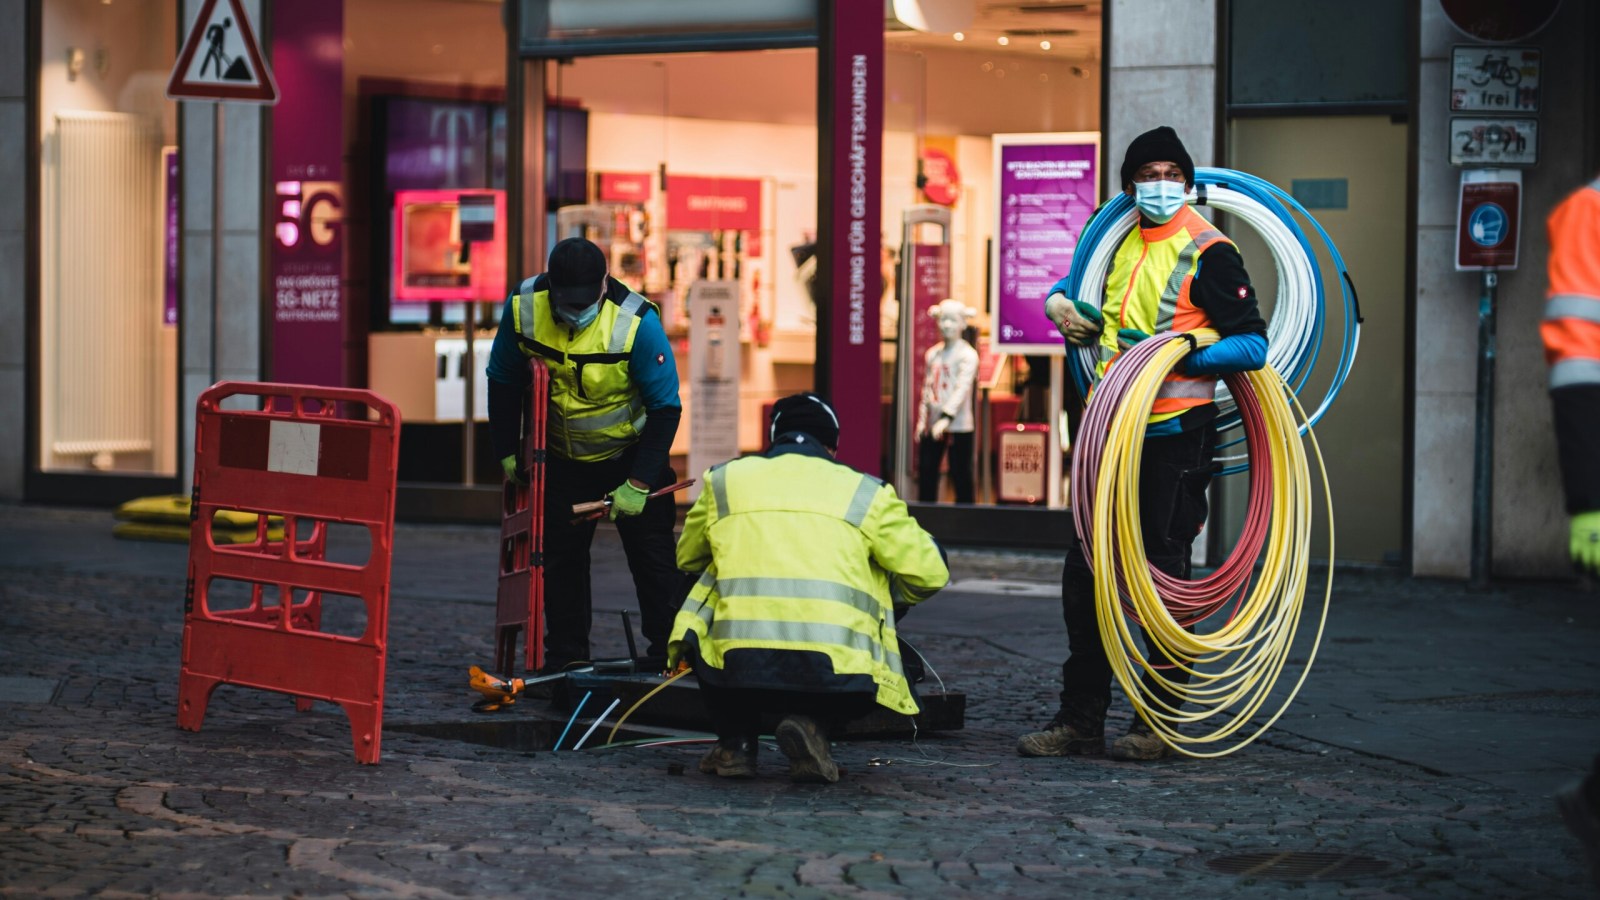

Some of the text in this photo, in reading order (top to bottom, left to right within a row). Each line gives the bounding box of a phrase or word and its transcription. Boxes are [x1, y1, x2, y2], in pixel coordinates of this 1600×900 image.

[1481, 90, 1510, 106] frei
[849, 55, 867, 344] BERATUNG FÜR GESCHÄFTSKUNDEN
[275, 184, 343, 252] 5G
[276, 274, 340, 289] DAS GRÖSSTE
[276, 289, 340, 309] 5G-NETZ
